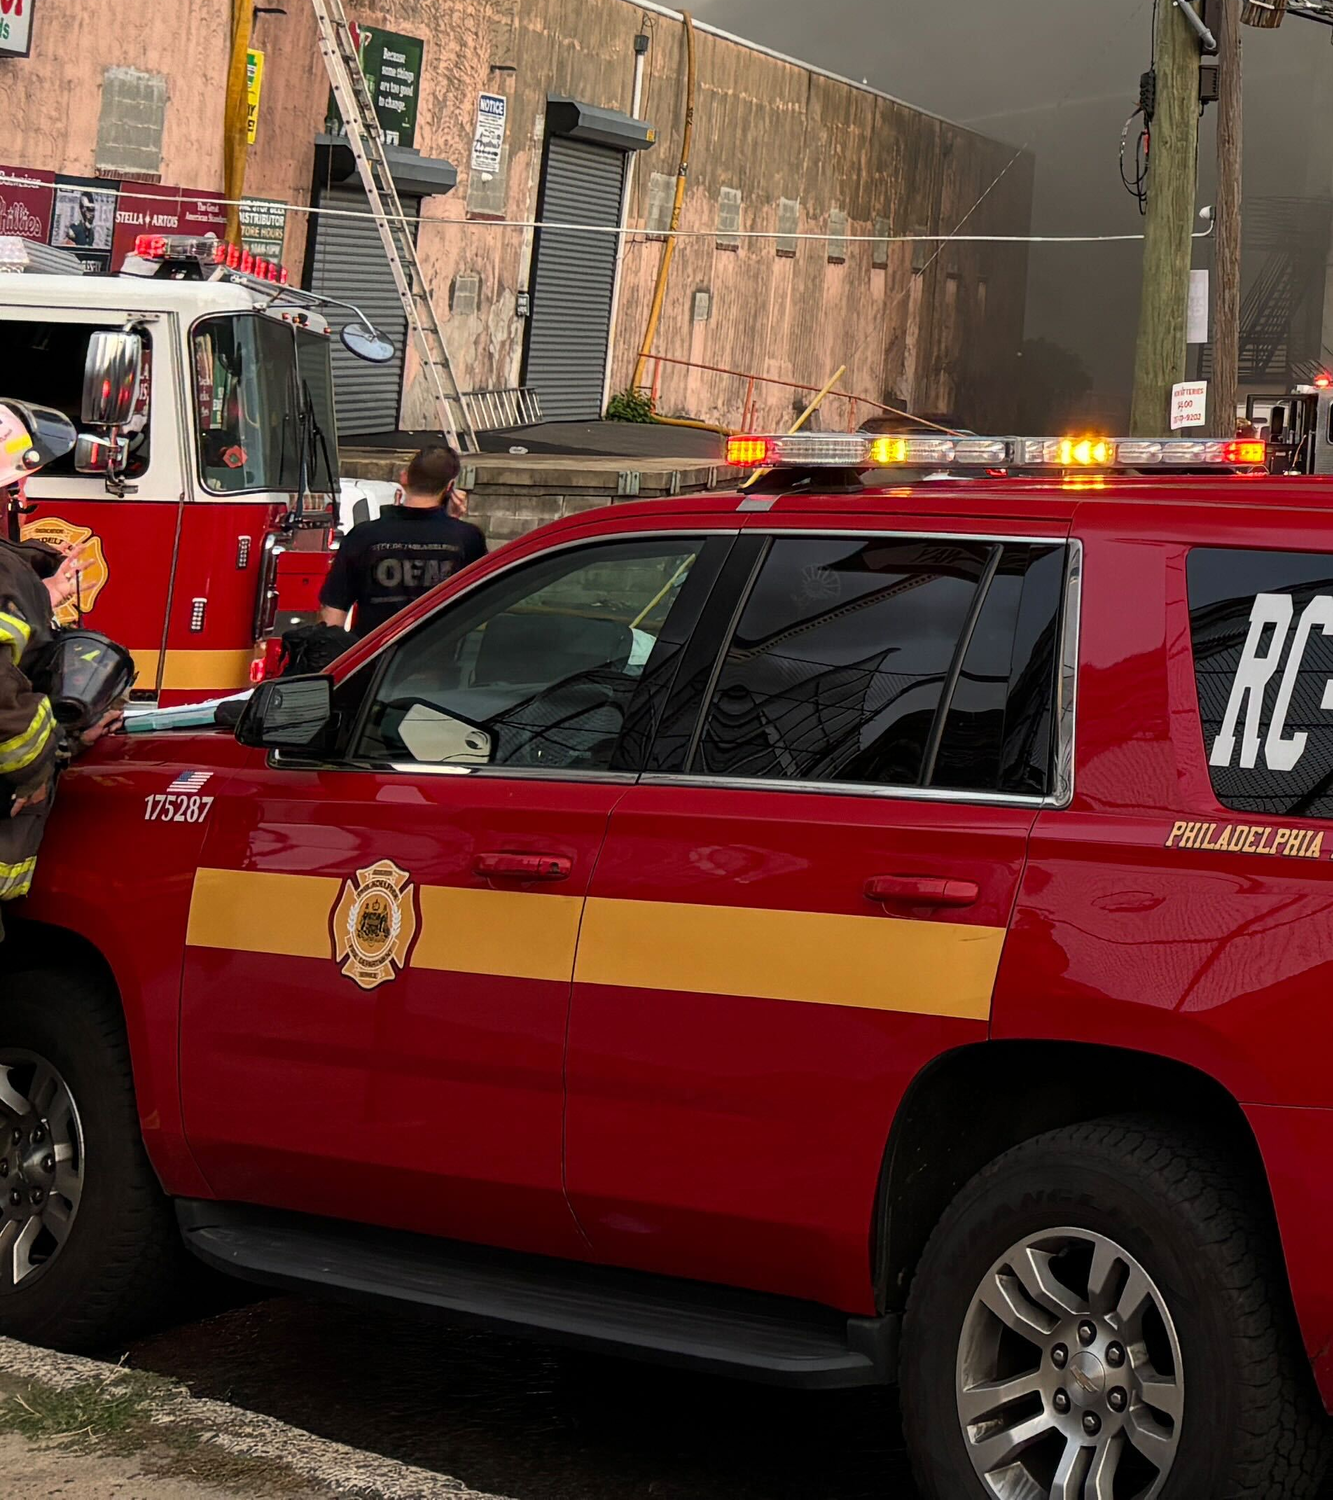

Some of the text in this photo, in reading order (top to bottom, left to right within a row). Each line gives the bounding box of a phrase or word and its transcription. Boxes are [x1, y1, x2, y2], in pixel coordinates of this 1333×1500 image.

[383, 47, 406, 63] Because
[382, 66, 414, 83] some things
[380, 81, 414, 97] are too good
[378, 96, 385, 106] to
[480, 98, 504, 114] NOTICE
[116, 211, 178, 228] STELLA ARTOIS
[241, 225, 284, 239] TORE HOURS
[144, 793, 215, 823] 175287
[1165, 821, 1325, 858] PHILADELPHIA
